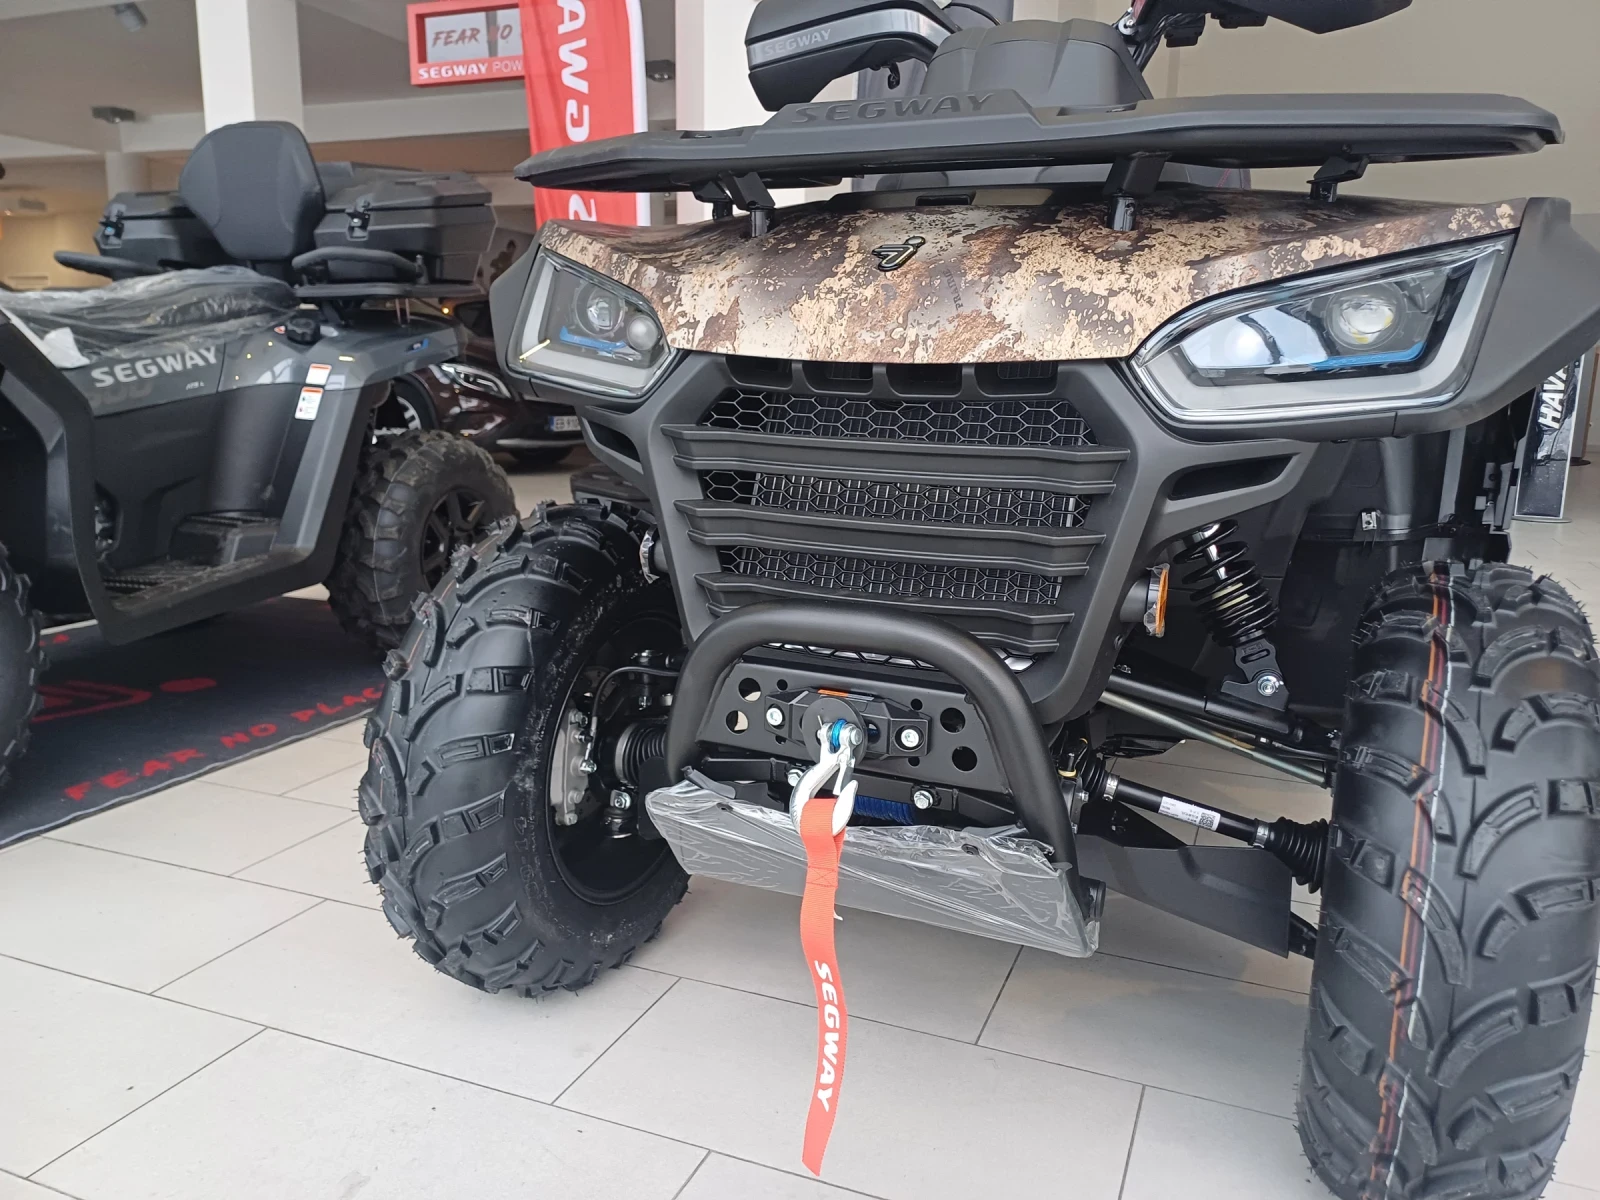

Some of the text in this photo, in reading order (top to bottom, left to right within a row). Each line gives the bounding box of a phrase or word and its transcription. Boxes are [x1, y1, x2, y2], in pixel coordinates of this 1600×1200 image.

[432, 28, 480, 48] FEAR
[764, 29, 831, 56] SEGWAY
[418, 63, 488, 79] SEGWAY
[792, 93, 994, 123] SEGWAY
[91, 346, 217, 387] SEGWAY
[64, 684, 385, 801] FEAR NO PLAC
[814, 959, 840, 1112] SEGWAY
